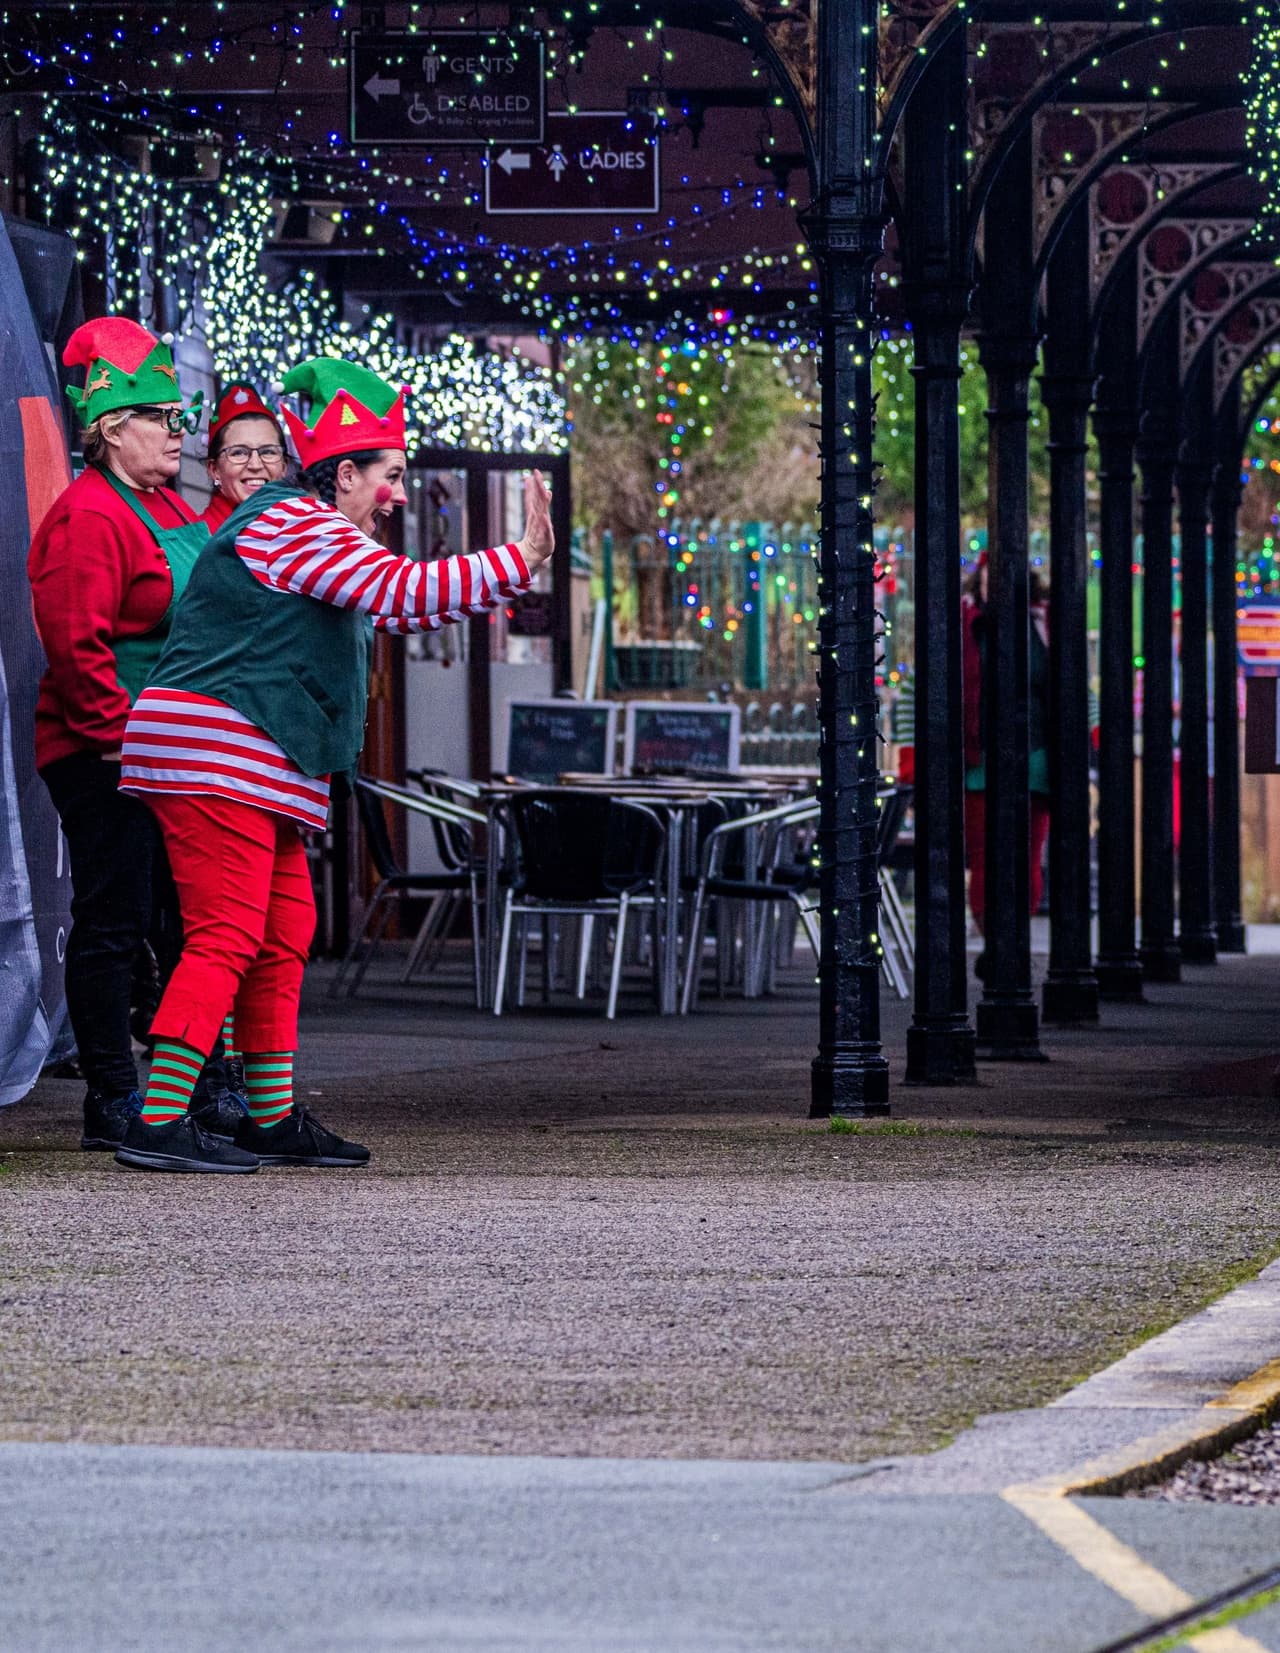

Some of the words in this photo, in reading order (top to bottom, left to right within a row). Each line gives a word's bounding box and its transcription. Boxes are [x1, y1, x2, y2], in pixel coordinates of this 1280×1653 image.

[450, 57, 515, 74] GENTS
[438, 95, 531, 113] DISABLED
[579, 151, 646, 170] LADIES
